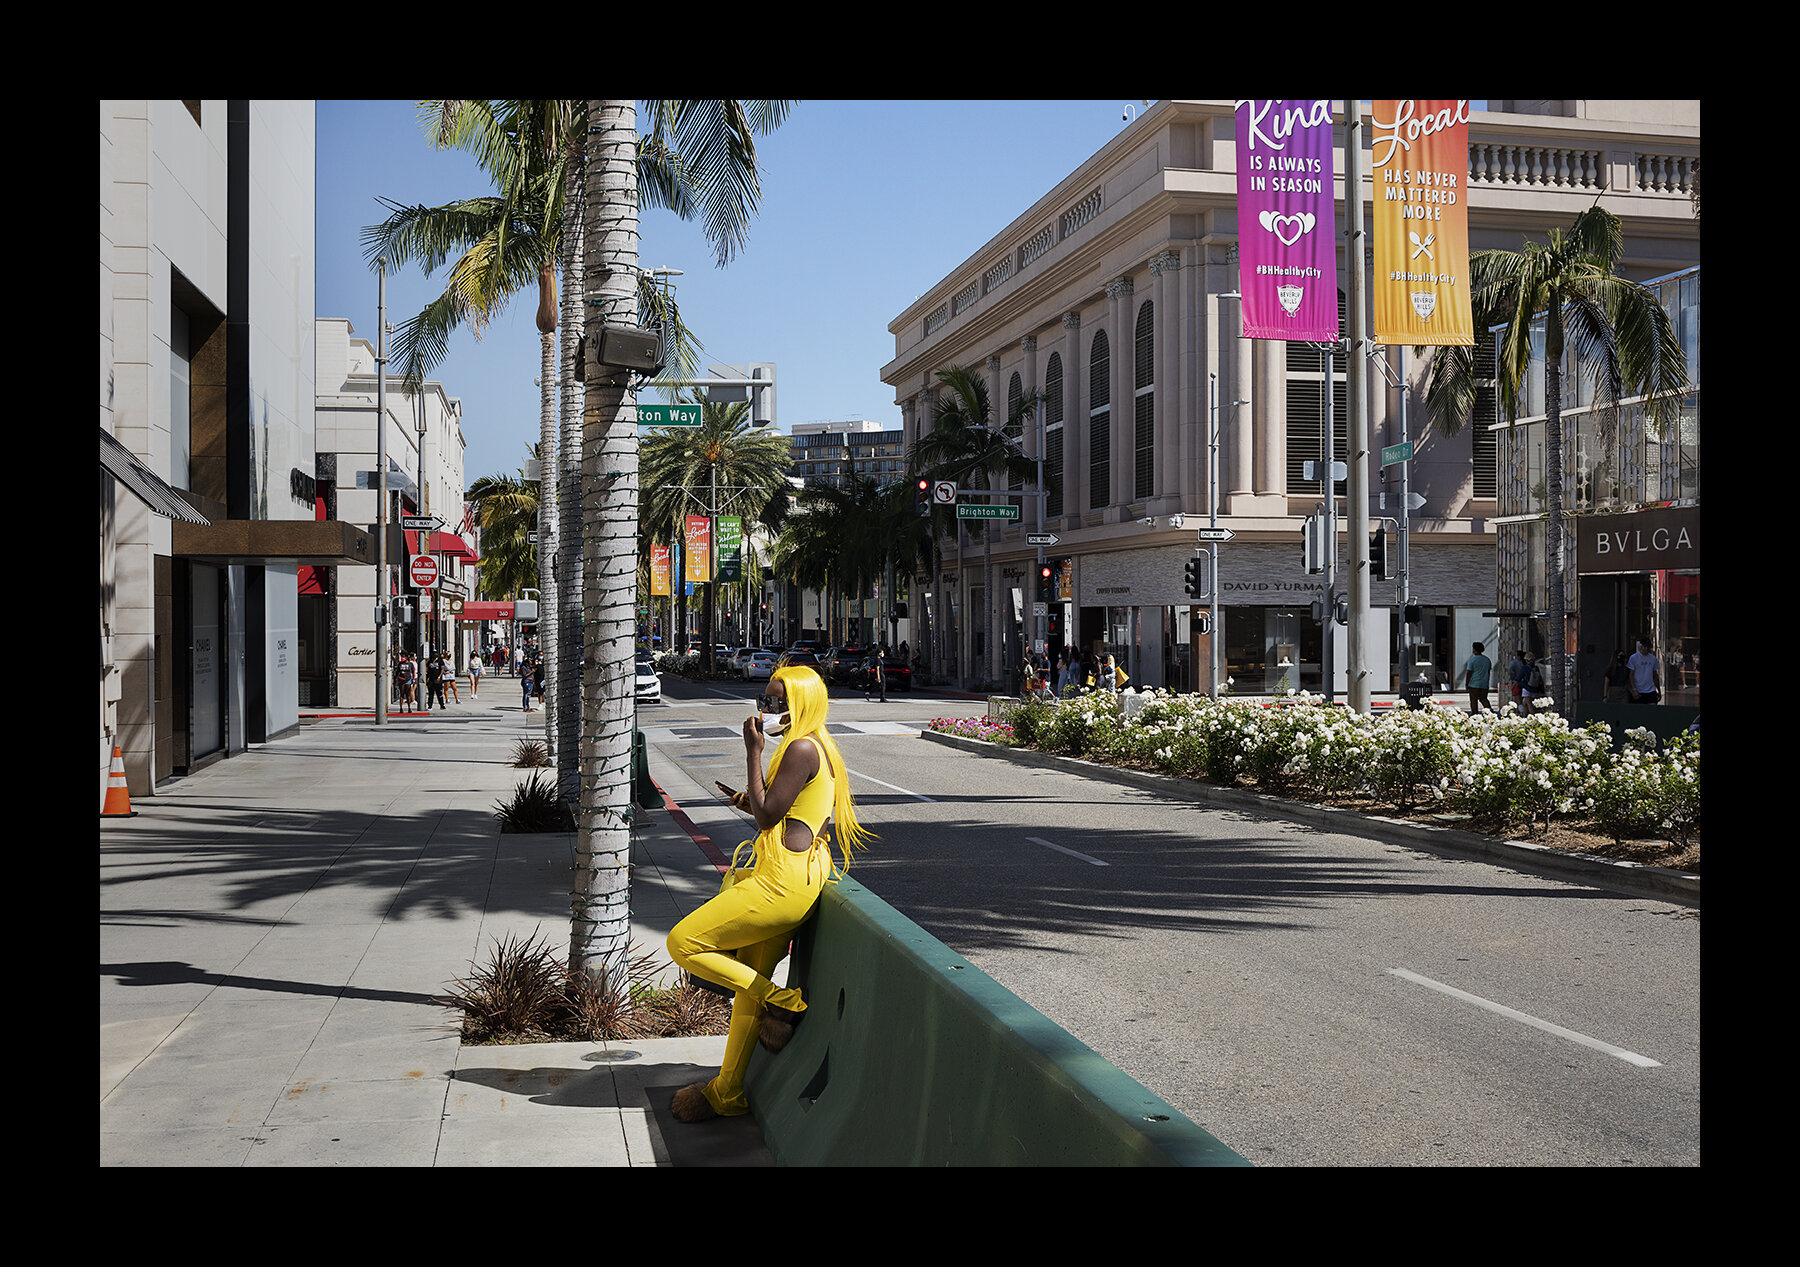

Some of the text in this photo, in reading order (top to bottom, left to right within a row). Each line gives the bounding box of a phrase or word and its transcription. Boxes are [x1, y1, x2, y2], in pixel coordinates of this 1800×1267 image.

[1235, 100, 1333, 150] Kind
[1372, 100, 1469, 168] Local
[1250, 155, 1322, 174] IS ALWAYS
[1250, 176, 1322, 194] IN SEASON
[1384, 169, 1457, 188] HAS NEVER
[1385, 186, 1457, 205] MATTERED
[1403, 205, 1441, 221] MORE
[1256, 265, 1322, 279] #BHHealthyCity
[1390, 270, 1455, 286] #BHHealthyCity
[669, 409, 697, 424] Way
[960, 507, 1016, 518] Brighton Way
[685, 521, 711, 543] Local
[1596, 526, 1693, 554] BVLGA
[1223, 583, 1269, 591] DAVID
[348, 646, 376, 656] Cartier
